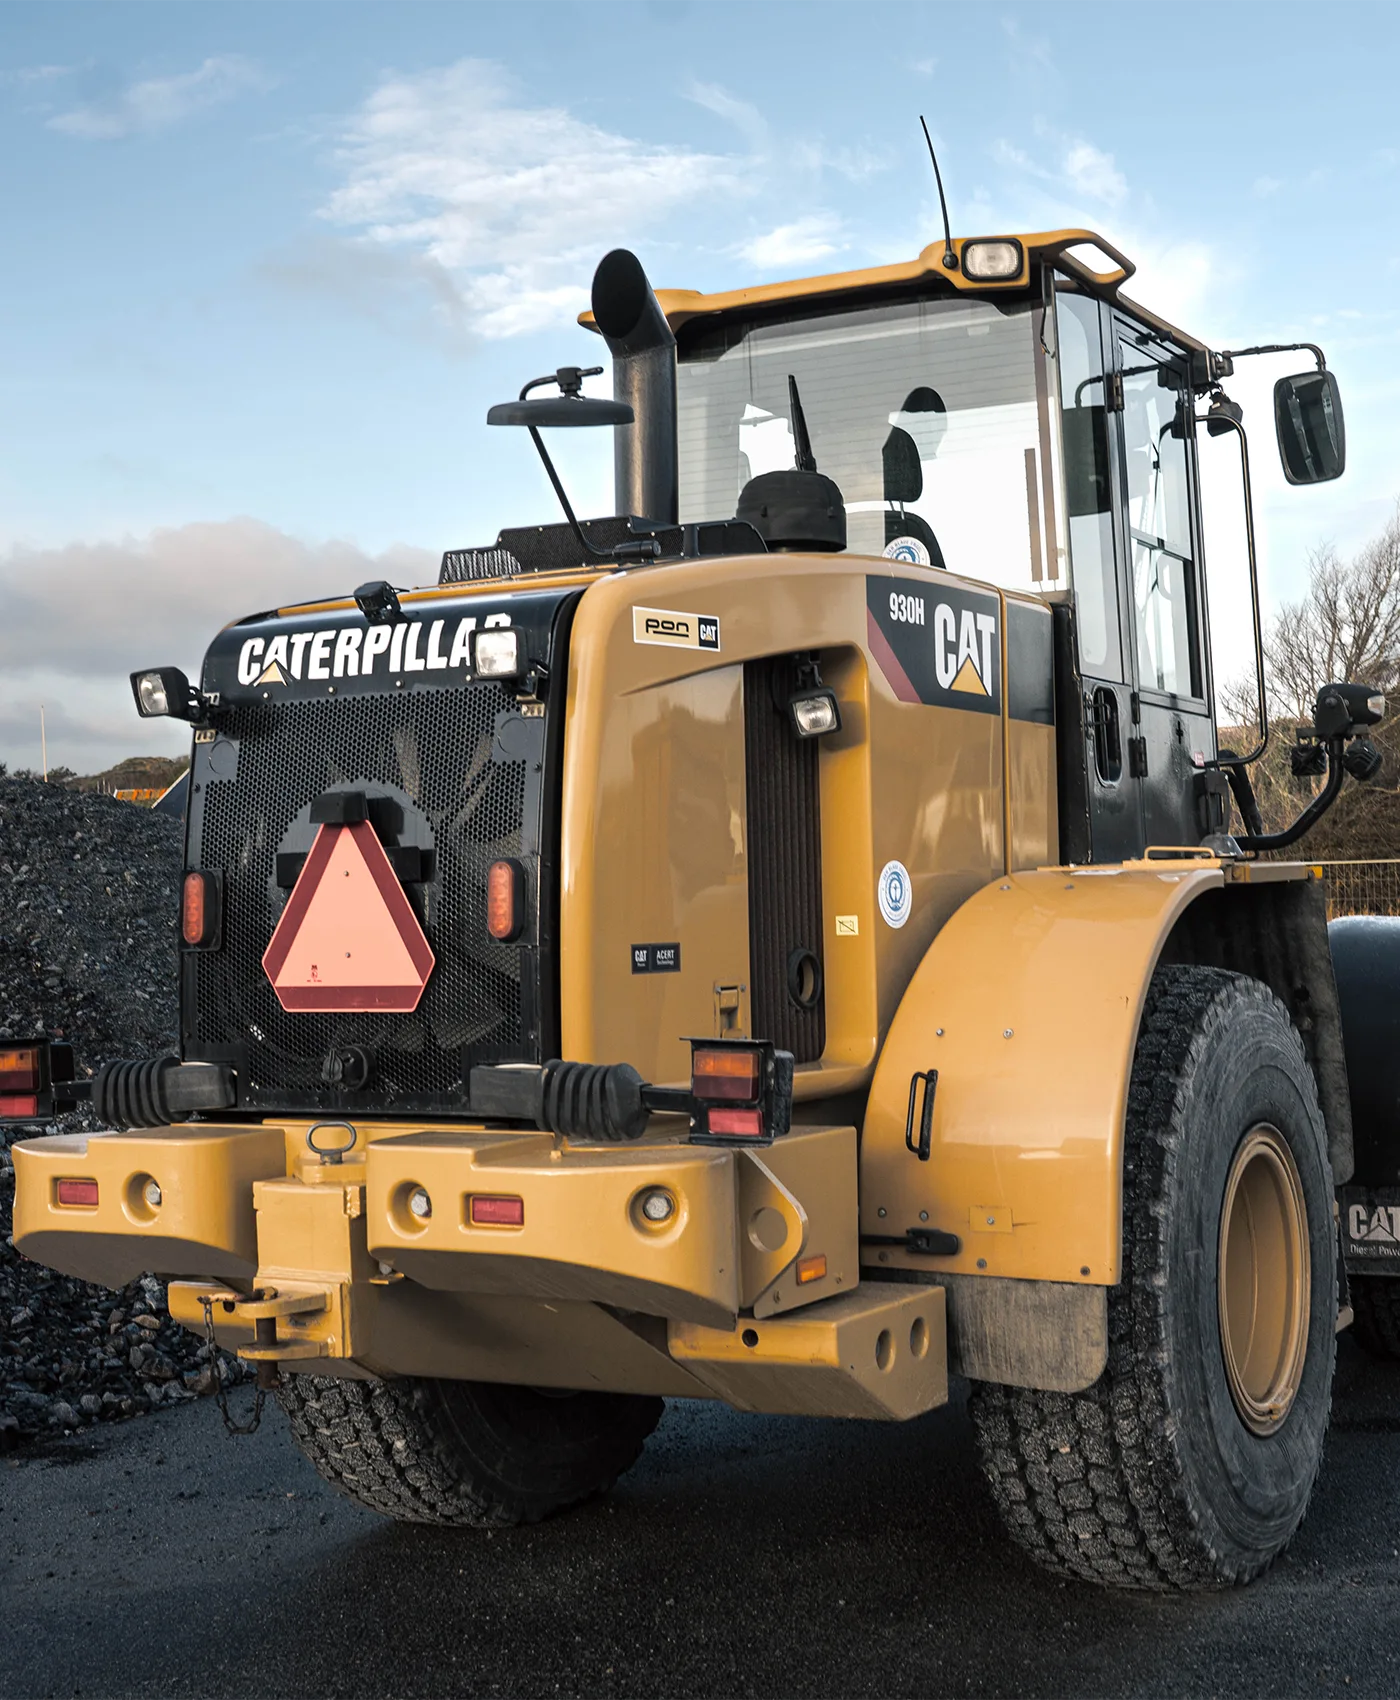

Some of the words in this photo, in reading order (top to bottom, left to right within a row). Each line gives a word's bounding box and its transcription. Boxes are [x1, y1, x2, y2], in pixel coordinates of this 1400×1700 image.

[889, 592, 925, 625] 930H
[646, 618, 689, 635] pon
[700, 624, 717, 641] CAT
[237, 613, 512, 686] CATERPILLA
[934, 603, 996, 697] CAT
[635, 950, 647, 962] CAT
[657, 950, 674, 960] ACERT
[1349, 1204, 1400, 1242] CAT
